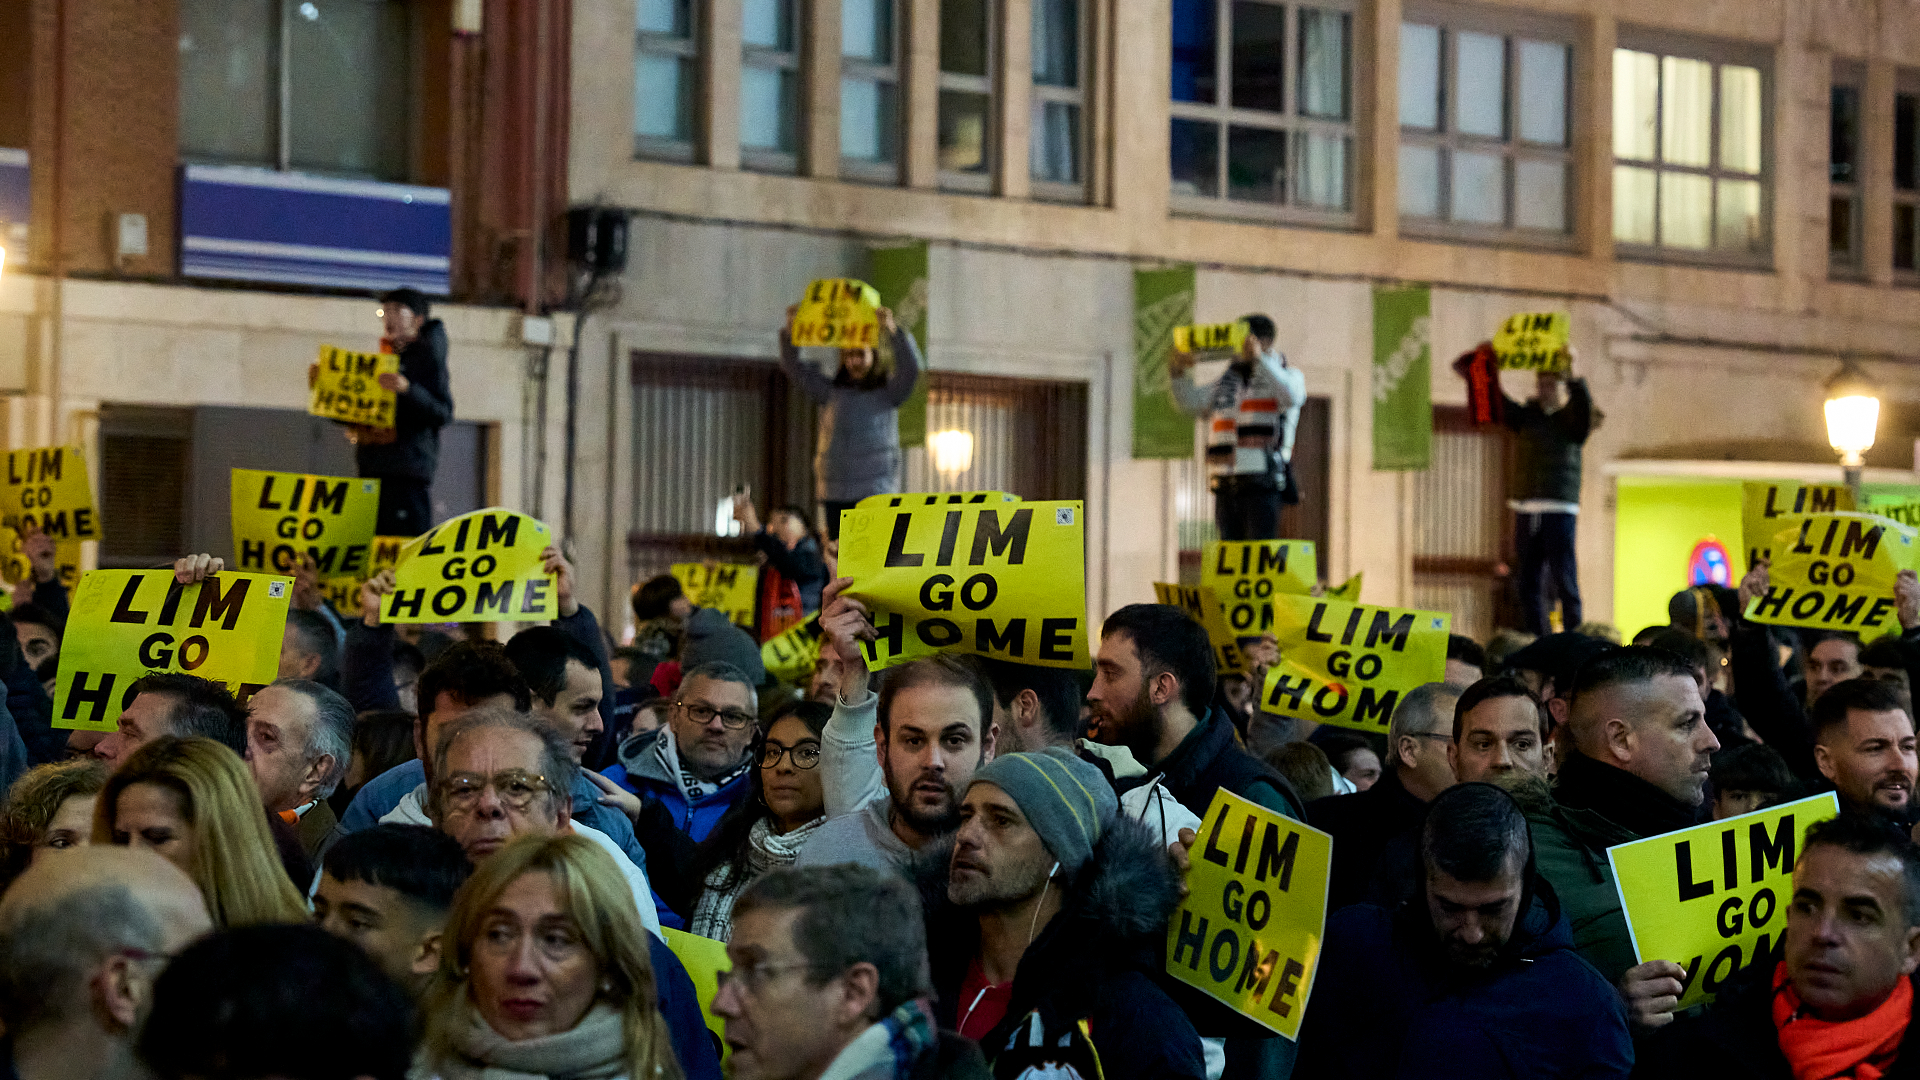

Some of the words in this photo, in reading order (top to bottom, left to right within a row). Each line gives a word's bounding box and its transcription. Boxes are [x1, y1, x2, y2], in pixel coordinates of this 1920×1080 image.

[810, 279, 863, 304] LIM
[797, 321, 874, 343] HOME
[1187, 323, 1232, 347] LIM
[1503, 313, 1553, 334] LIM
[328, 347, 378, 378] LIM
[8, 447, 64, 485] LIM
[21, 485, 52, 509] GO
[258, 475, 350, 515] LIM
[1763, 486, 1837, 518] LIM
[276, 515, 325, 541] GO
[418, 514, 521, 557] LIM
[883, 508, 1035, 568] LIM
[1792, 519, 1887, 560] LIM
[441, 554, 497, 580] GO
[1216, 544, 1290, 576] LIM
[1807, 560, 1856, 587] GO
[109, 574, 253, 632] LIM
[387, 579, 551, 618] HOME
[919, 572, 999, 612] GO
[1234, 578, 1275, 600] GO
[1754, 585, 1896, 628] HOME
[865, 610, 1079, 663] HOME
[1306, 602, 1417, 653] LIM
[138, 632, 210, 672] GO
[1326, 650, 1384, 681] GO
[1267, 674, 1400, 726] HOM
[1203, 802, 1301, 894] LIM
[1674, 813, 1796, 903] LIM
[1222, 879, 1272, 933] GO
[1716, 887, 1777, 939] GO
[1172, 908, 1305, 1020] HOME
